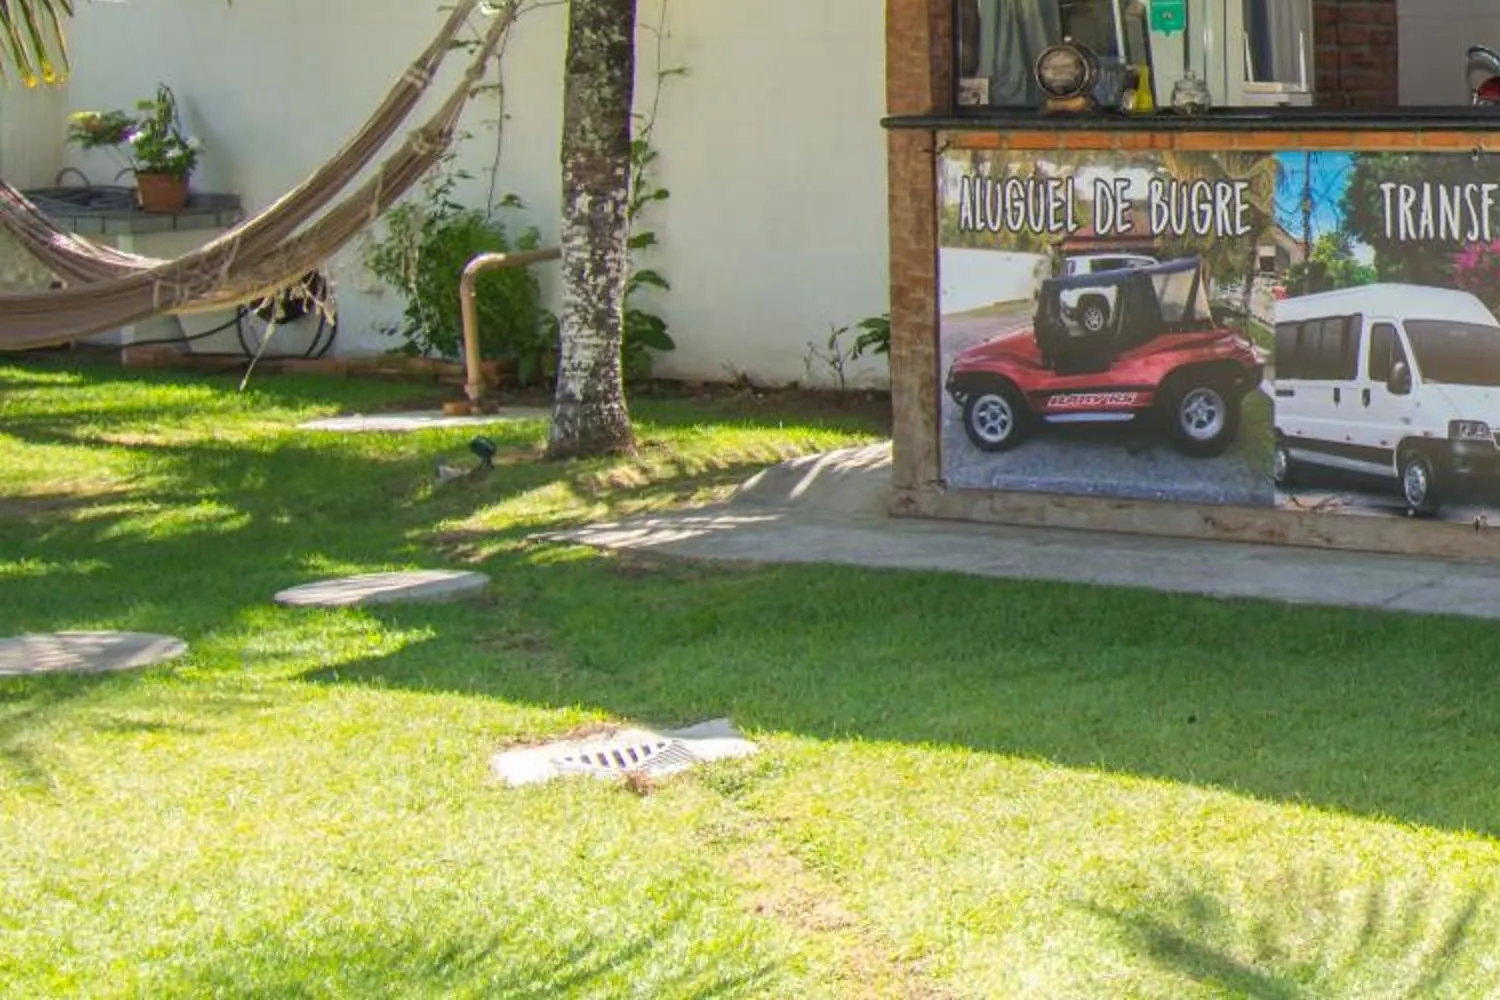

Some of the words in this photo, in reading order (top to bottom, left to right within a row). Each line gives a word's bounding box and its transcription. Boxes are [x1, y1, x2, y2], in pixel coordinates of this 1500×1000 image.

[959, 176, 1081, 233] ALUGUEL
[1094, 177, 1133, 235] DE
[1150, 178, 1252, 237] BUGRE
